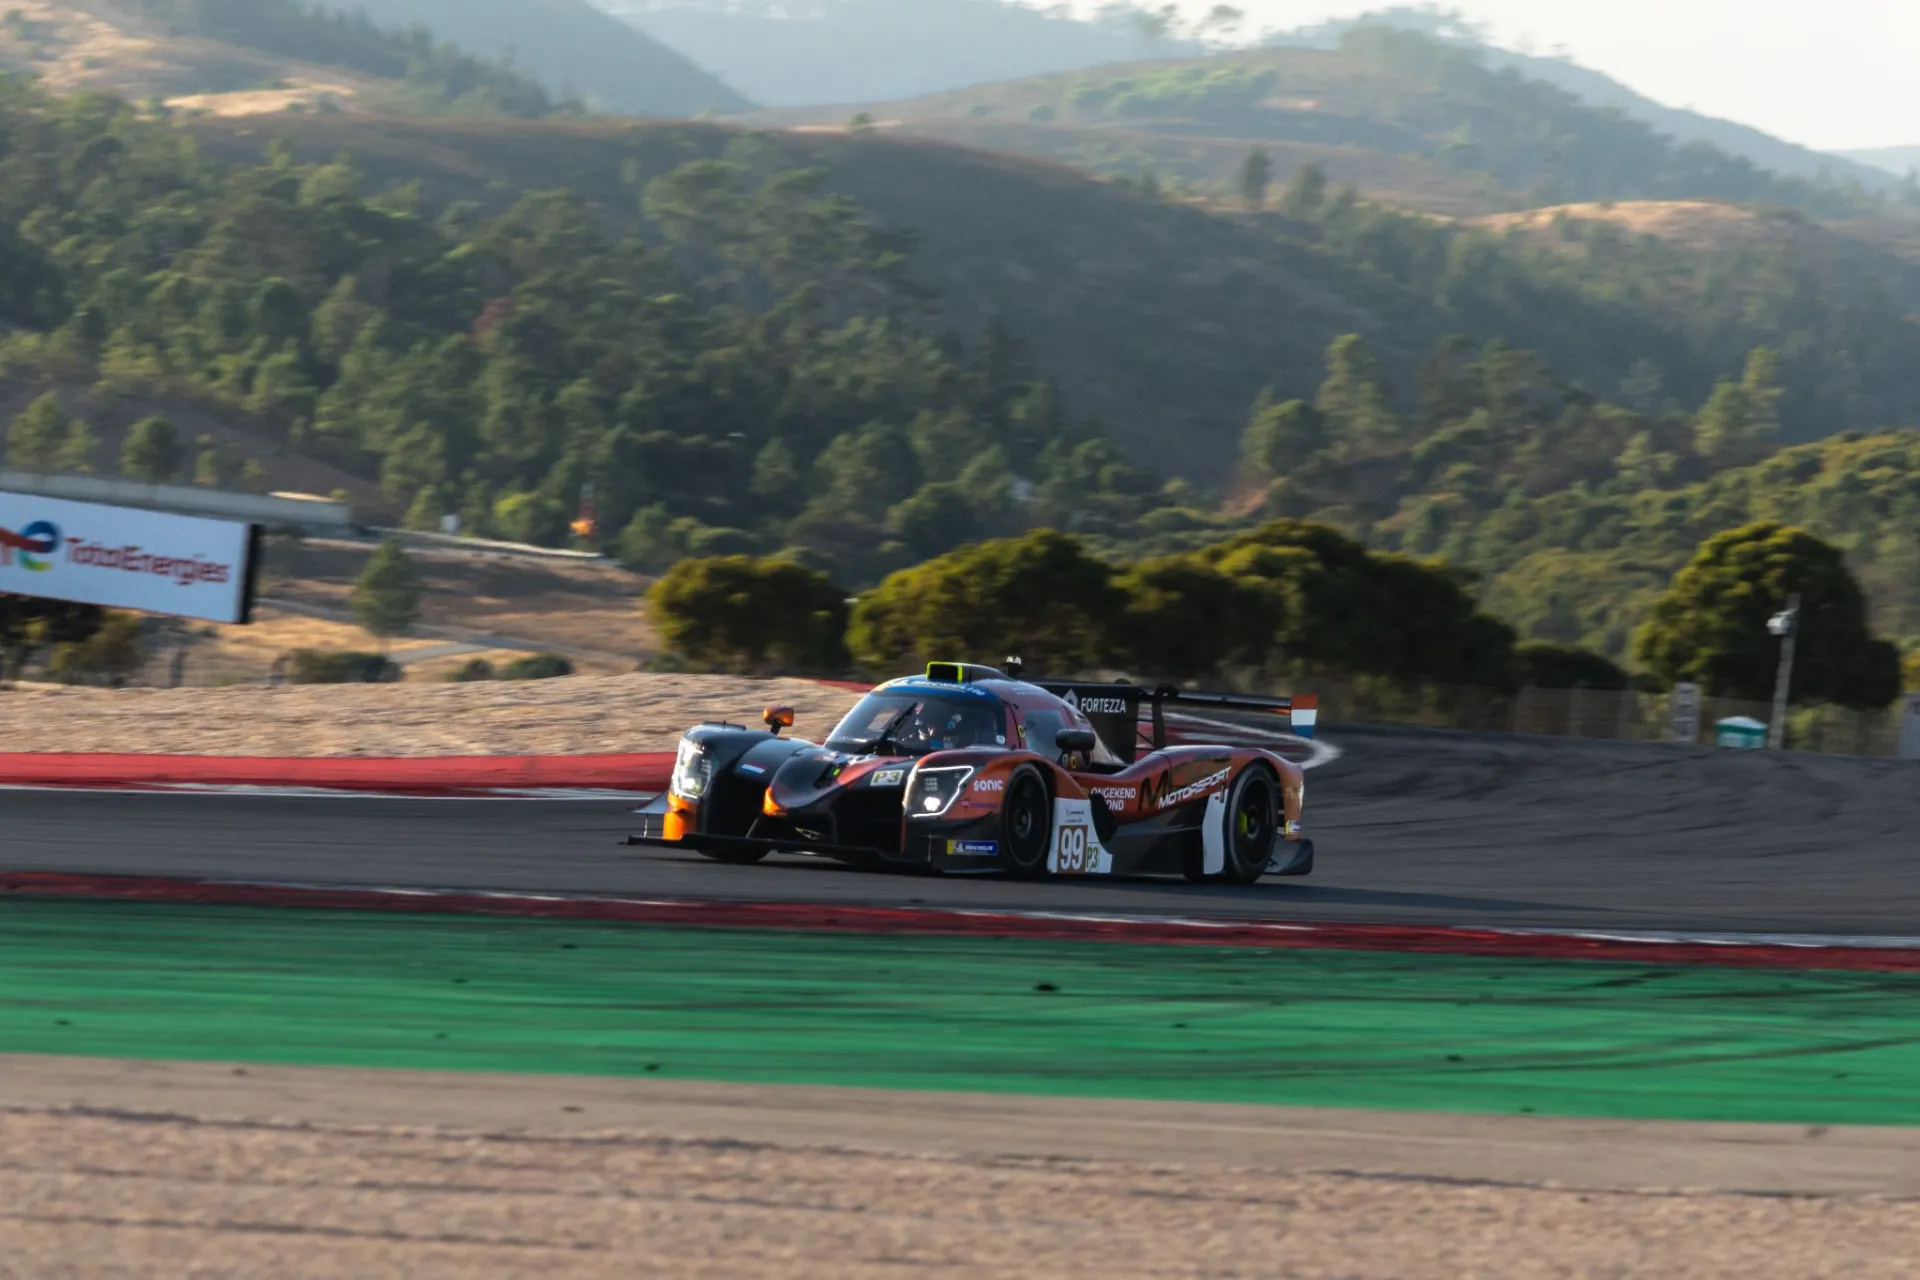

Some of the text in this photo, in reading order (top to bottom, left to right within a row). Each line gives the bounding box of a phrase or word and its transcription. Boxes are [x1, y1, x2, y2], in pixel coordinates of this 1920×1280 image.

[65, 535, 231, 586] TotalEnergies
[1080, 697, 1127, 714] FORTEZZA
[873, 771, 901, 784] P3
[1158, 766, 1232, 809] MOTORSPORT
[1060, 828, 1084, 871] 99
[1086, 845, 1099, 869] P3
